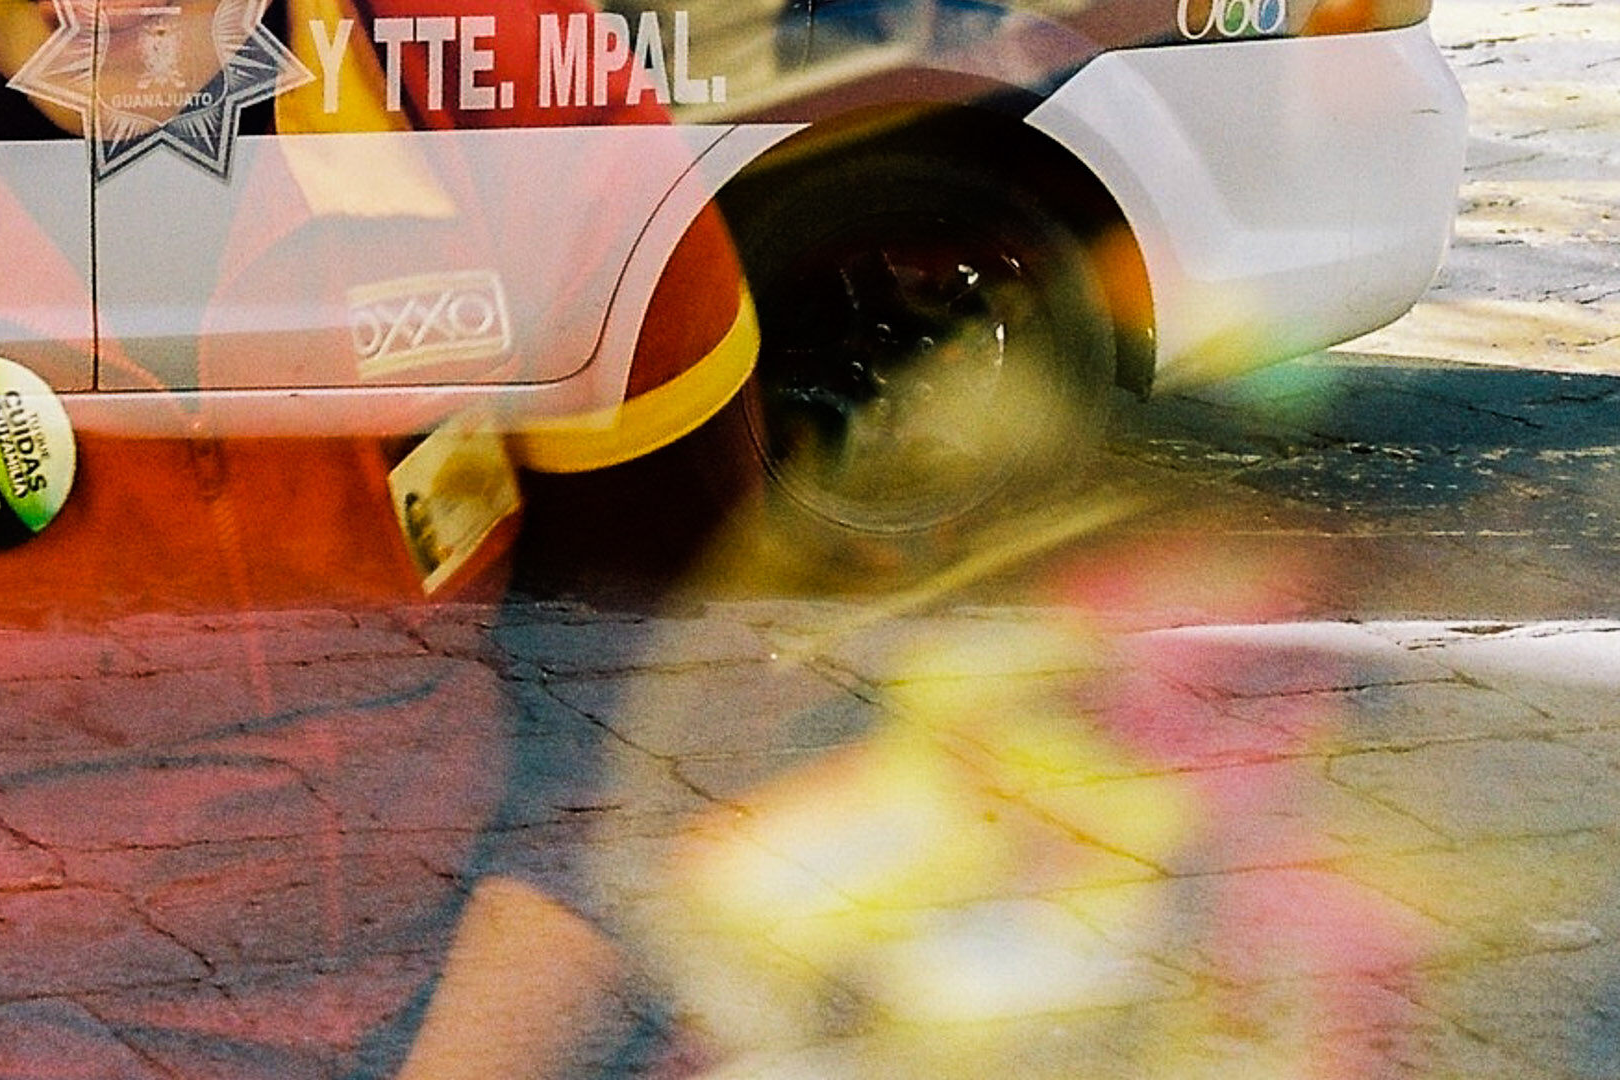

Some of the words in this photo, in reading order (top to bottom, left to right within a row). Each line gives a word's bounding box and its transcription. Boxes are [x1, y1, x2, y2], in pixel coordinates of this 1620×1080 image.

[111, 91, 213, 108] GUANAJUATO
[309, 19, 354, 114] Y
[374, 16, 514, 111] TTE.
[539, 10, 727, 109] MPAL.
[351, 291, 495, 360] OXXO
[4, 390, 48, 493] CUIDAS
